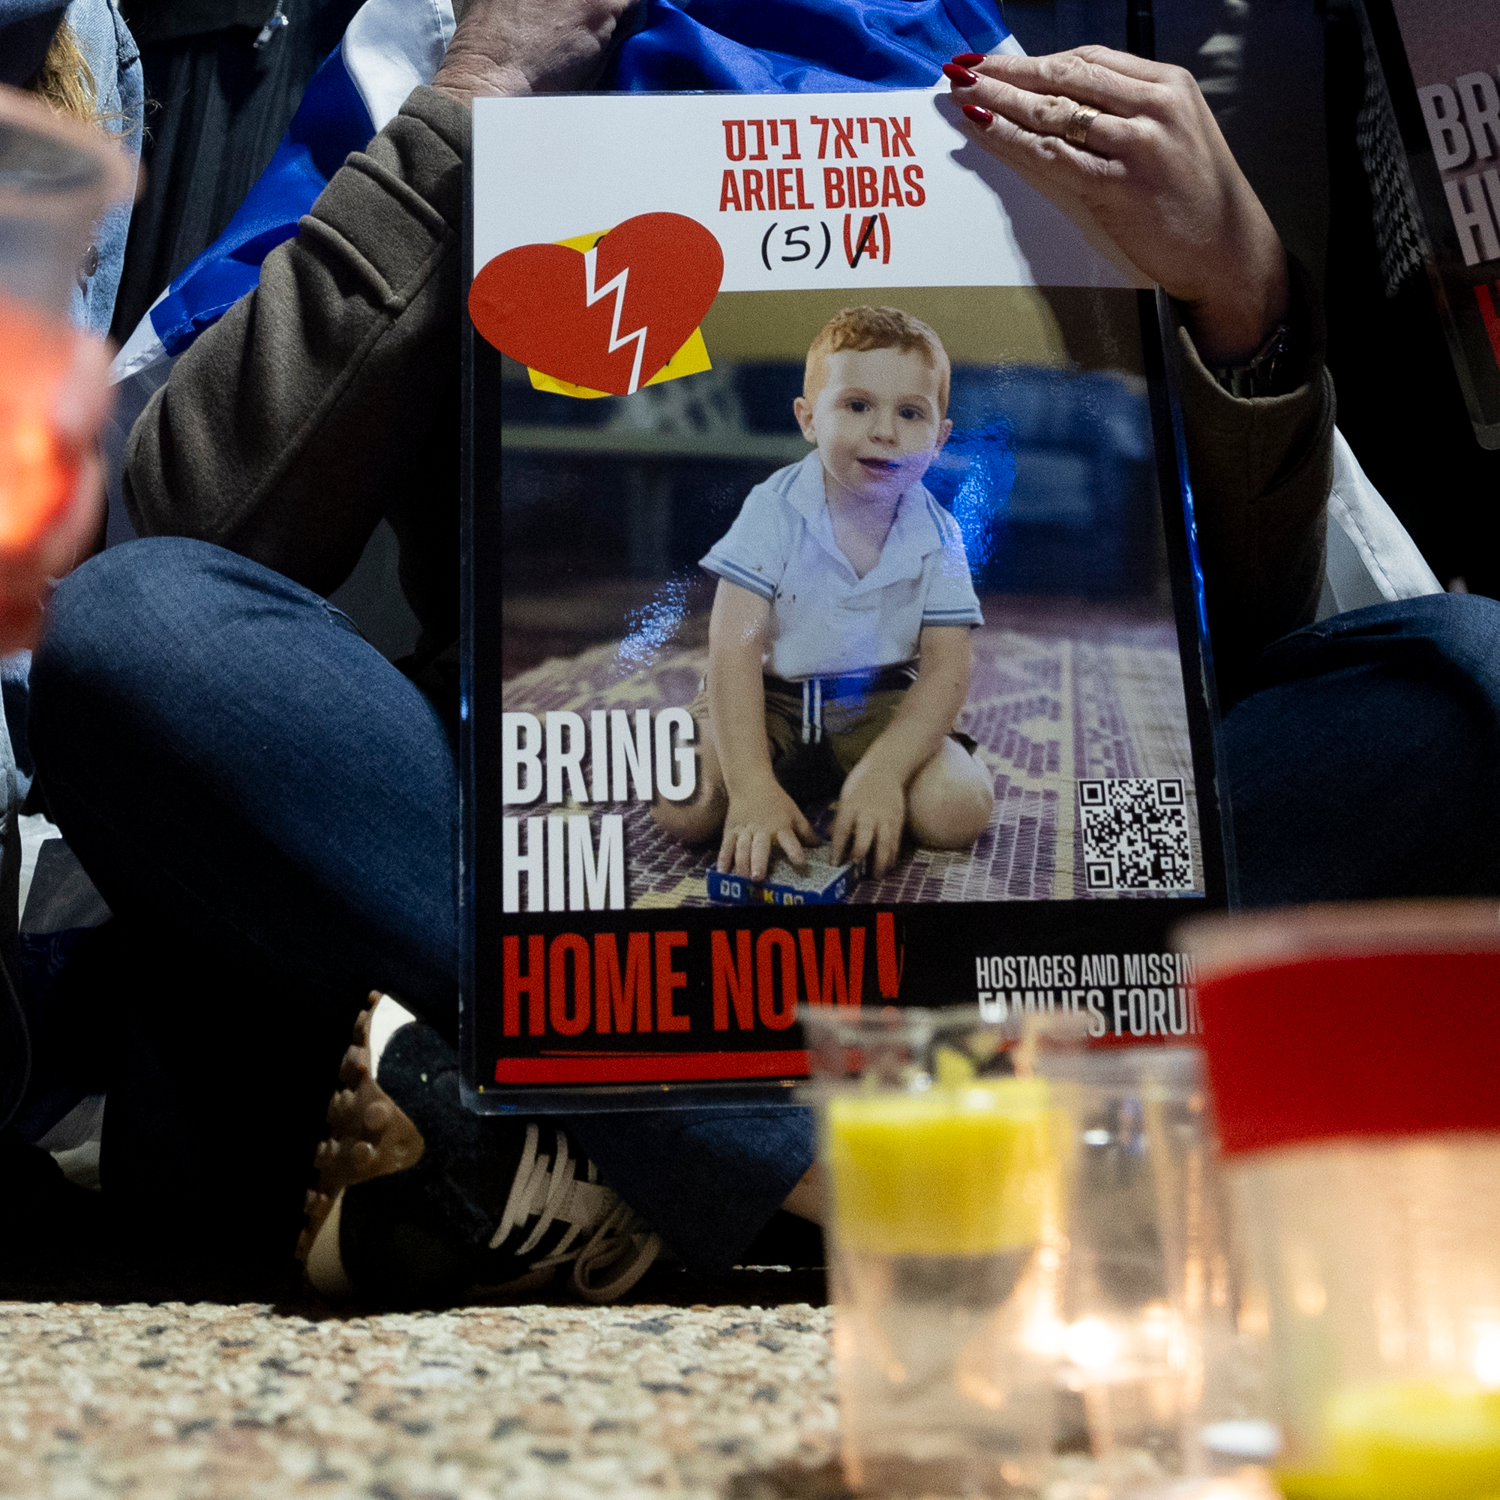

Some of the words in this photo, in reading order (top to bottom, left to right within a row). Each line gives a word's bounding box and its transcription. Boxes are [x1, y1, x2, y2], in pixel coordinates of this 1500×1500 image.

[723, 118, 801, 162] ביבס
[811, 114, 917, 160] אריאל
[719, 168, 815, 213] ARIEL
[823, 163, 927, 211] BIBAS
[761, 220, 831, 270] (5)
[842, 212, 892, 269] (4)
[502, 707, 697, 803] BRING
[502, 814, 625, 913] HIM
[502, 931, 691, 1037] HOME
[710, 911, 906, 1032] NOW!
[976, 954, 1077, 989] HOSTAGES
[1080, 953, 1120, 987] AND
[1123, 952, 1198, 987] MISSIN
